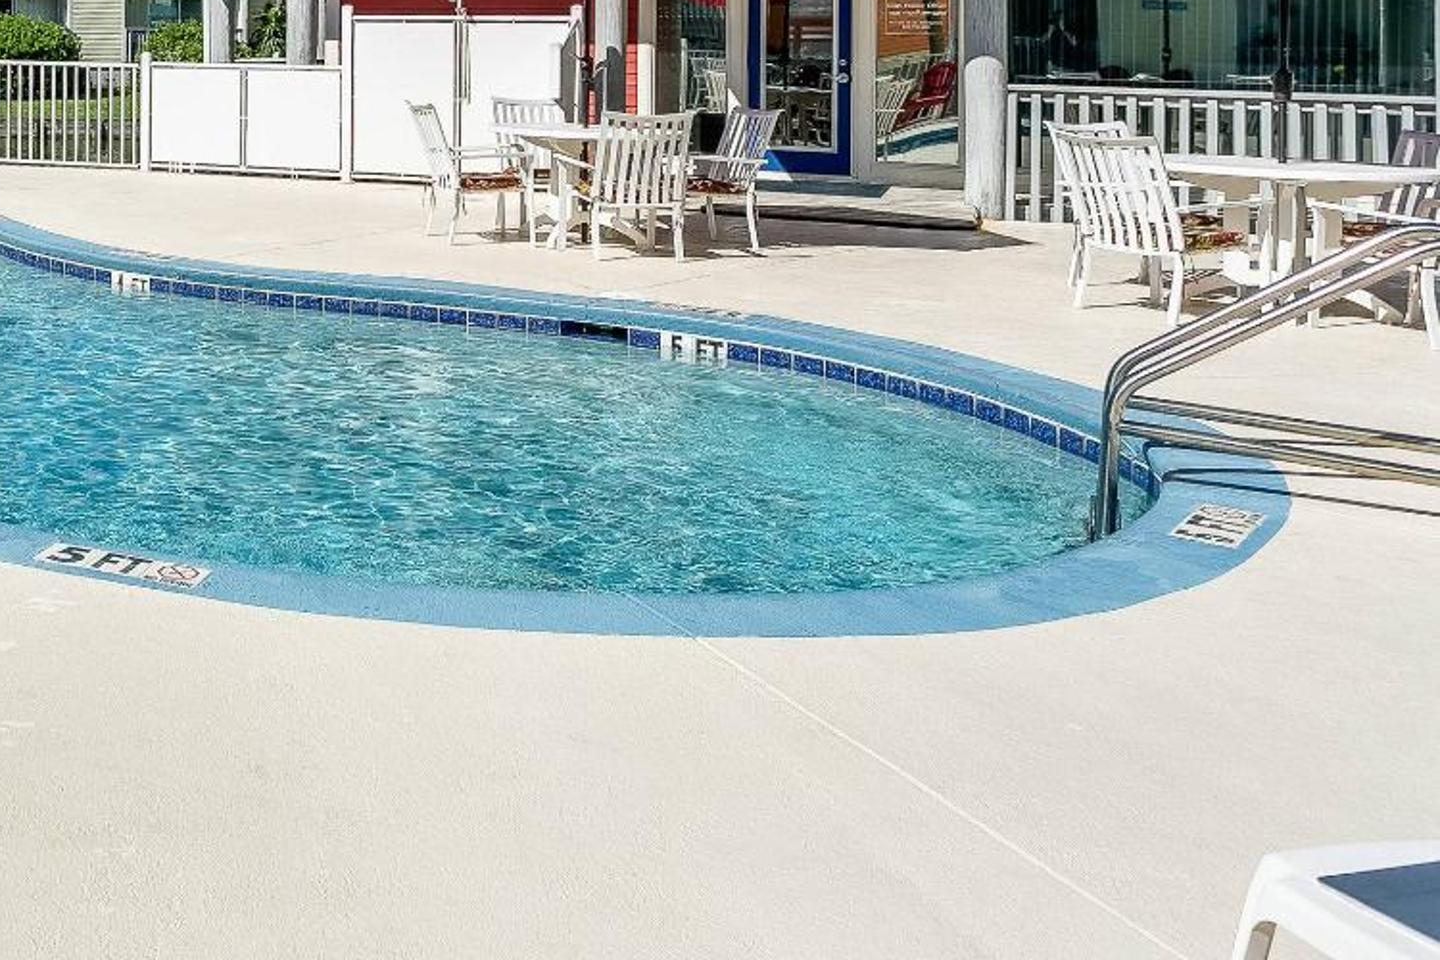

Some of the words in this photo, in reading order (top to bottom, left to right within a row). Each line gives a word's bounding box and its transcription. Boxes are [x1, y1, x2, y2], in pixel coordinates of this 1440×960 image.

[694, 339, 724, 362] FT
[48, 546, 91, 564] 5
[91, 552, 153, 575] FT
